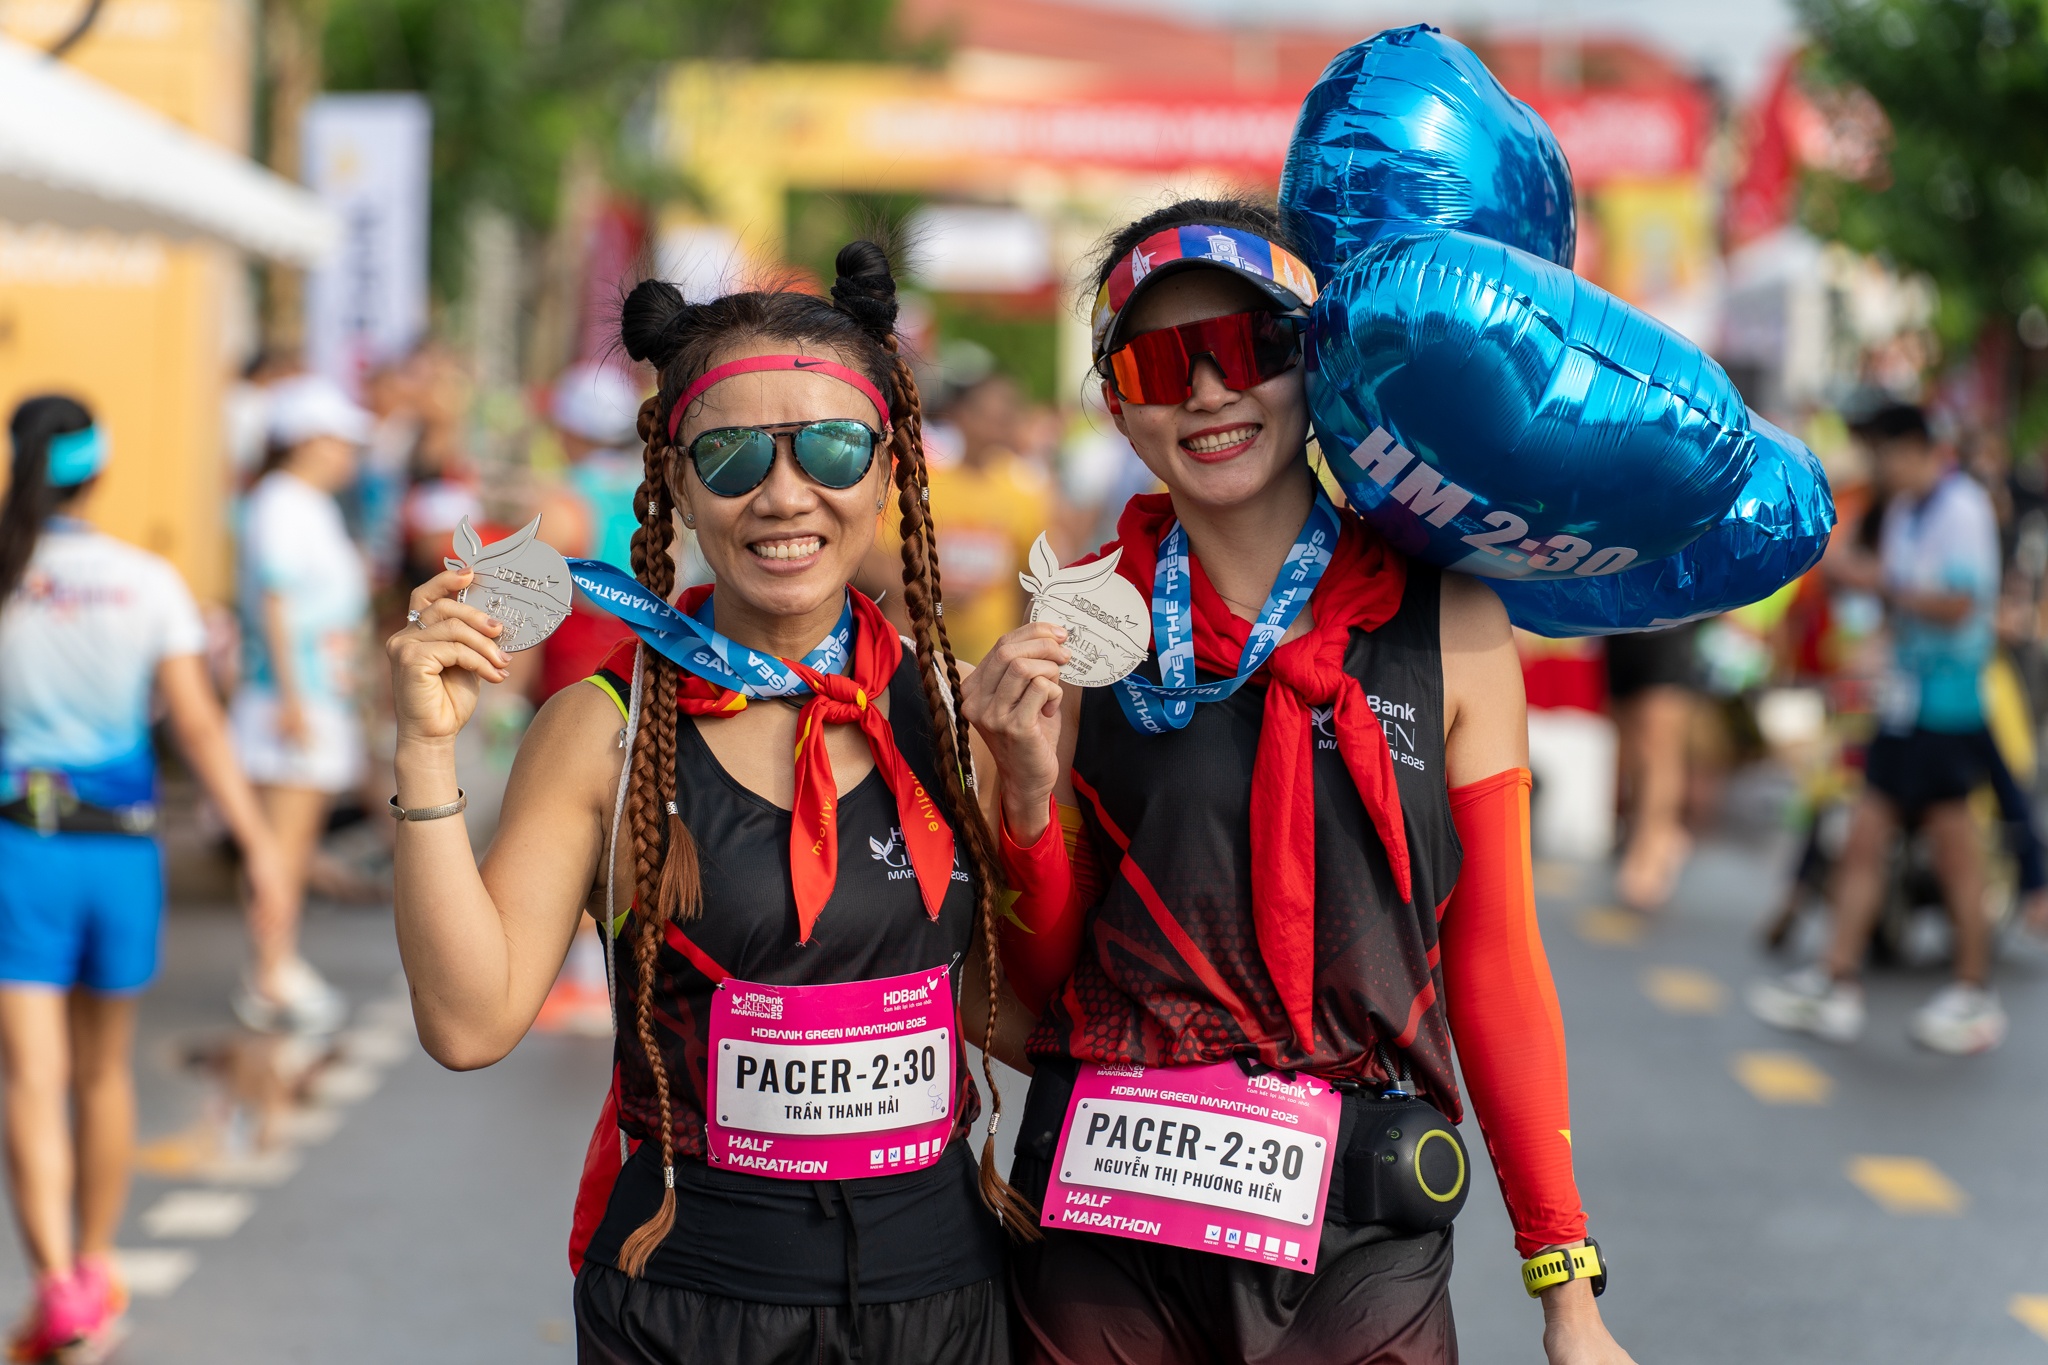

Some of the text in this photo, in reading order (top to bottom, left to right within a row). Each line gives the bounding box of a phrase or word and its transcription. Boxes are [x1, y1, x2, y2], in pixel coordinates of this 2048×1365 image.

[1349, 425, 1639, 578] HM 2:30
[494, 566, 545, 592] HDBank
[1070, 594, 1122, 630] HDBank
[1246, 529, 1326, 669] SAVE THE SEA
[1166, 600, 1181, 649] THE
[811, 627, 849, 675] SAVE
[693, 651, 743, 681] SAV
[747, 650, 787, 691] SEA
[1172, 655, 1186, 716] SVE
[1401, 752, 1425, 771] 2025
[951, 870, 969, 882] 2025
[745, 992, 784, 1005] HDBank
[883, 985, 929, 1006] HDBank
[731, 1008, 771, 1019] MARATHON
[770, 1012, 783, 1020] 25
[751, 1016, 927, 1040] HDBANK GREEN MARATHON 2025
[736, 1045, 936, 1095] PACER-2:30
[1248, 1075, 1306, 1099] HDBank
[784, 1095, 899, 1120] TRẦN THANH HẢI
[1110, 1085, 1299, 1125] HDBANK GREEN MARATHON 2025
[728, 1135, 774, 1152] HALF
[1085, 1112, 1304, 1181] PACER-2:30
[728, 1153, 828, 1174] MARATHON
[1094, 1156, 1282, 1203] NGUYỄN THỊ PHƯƠNG HIỀN
[1065, 1190, 1112, 1208] HALF
[1062, 1209, 1162, 1236] MARATHON
